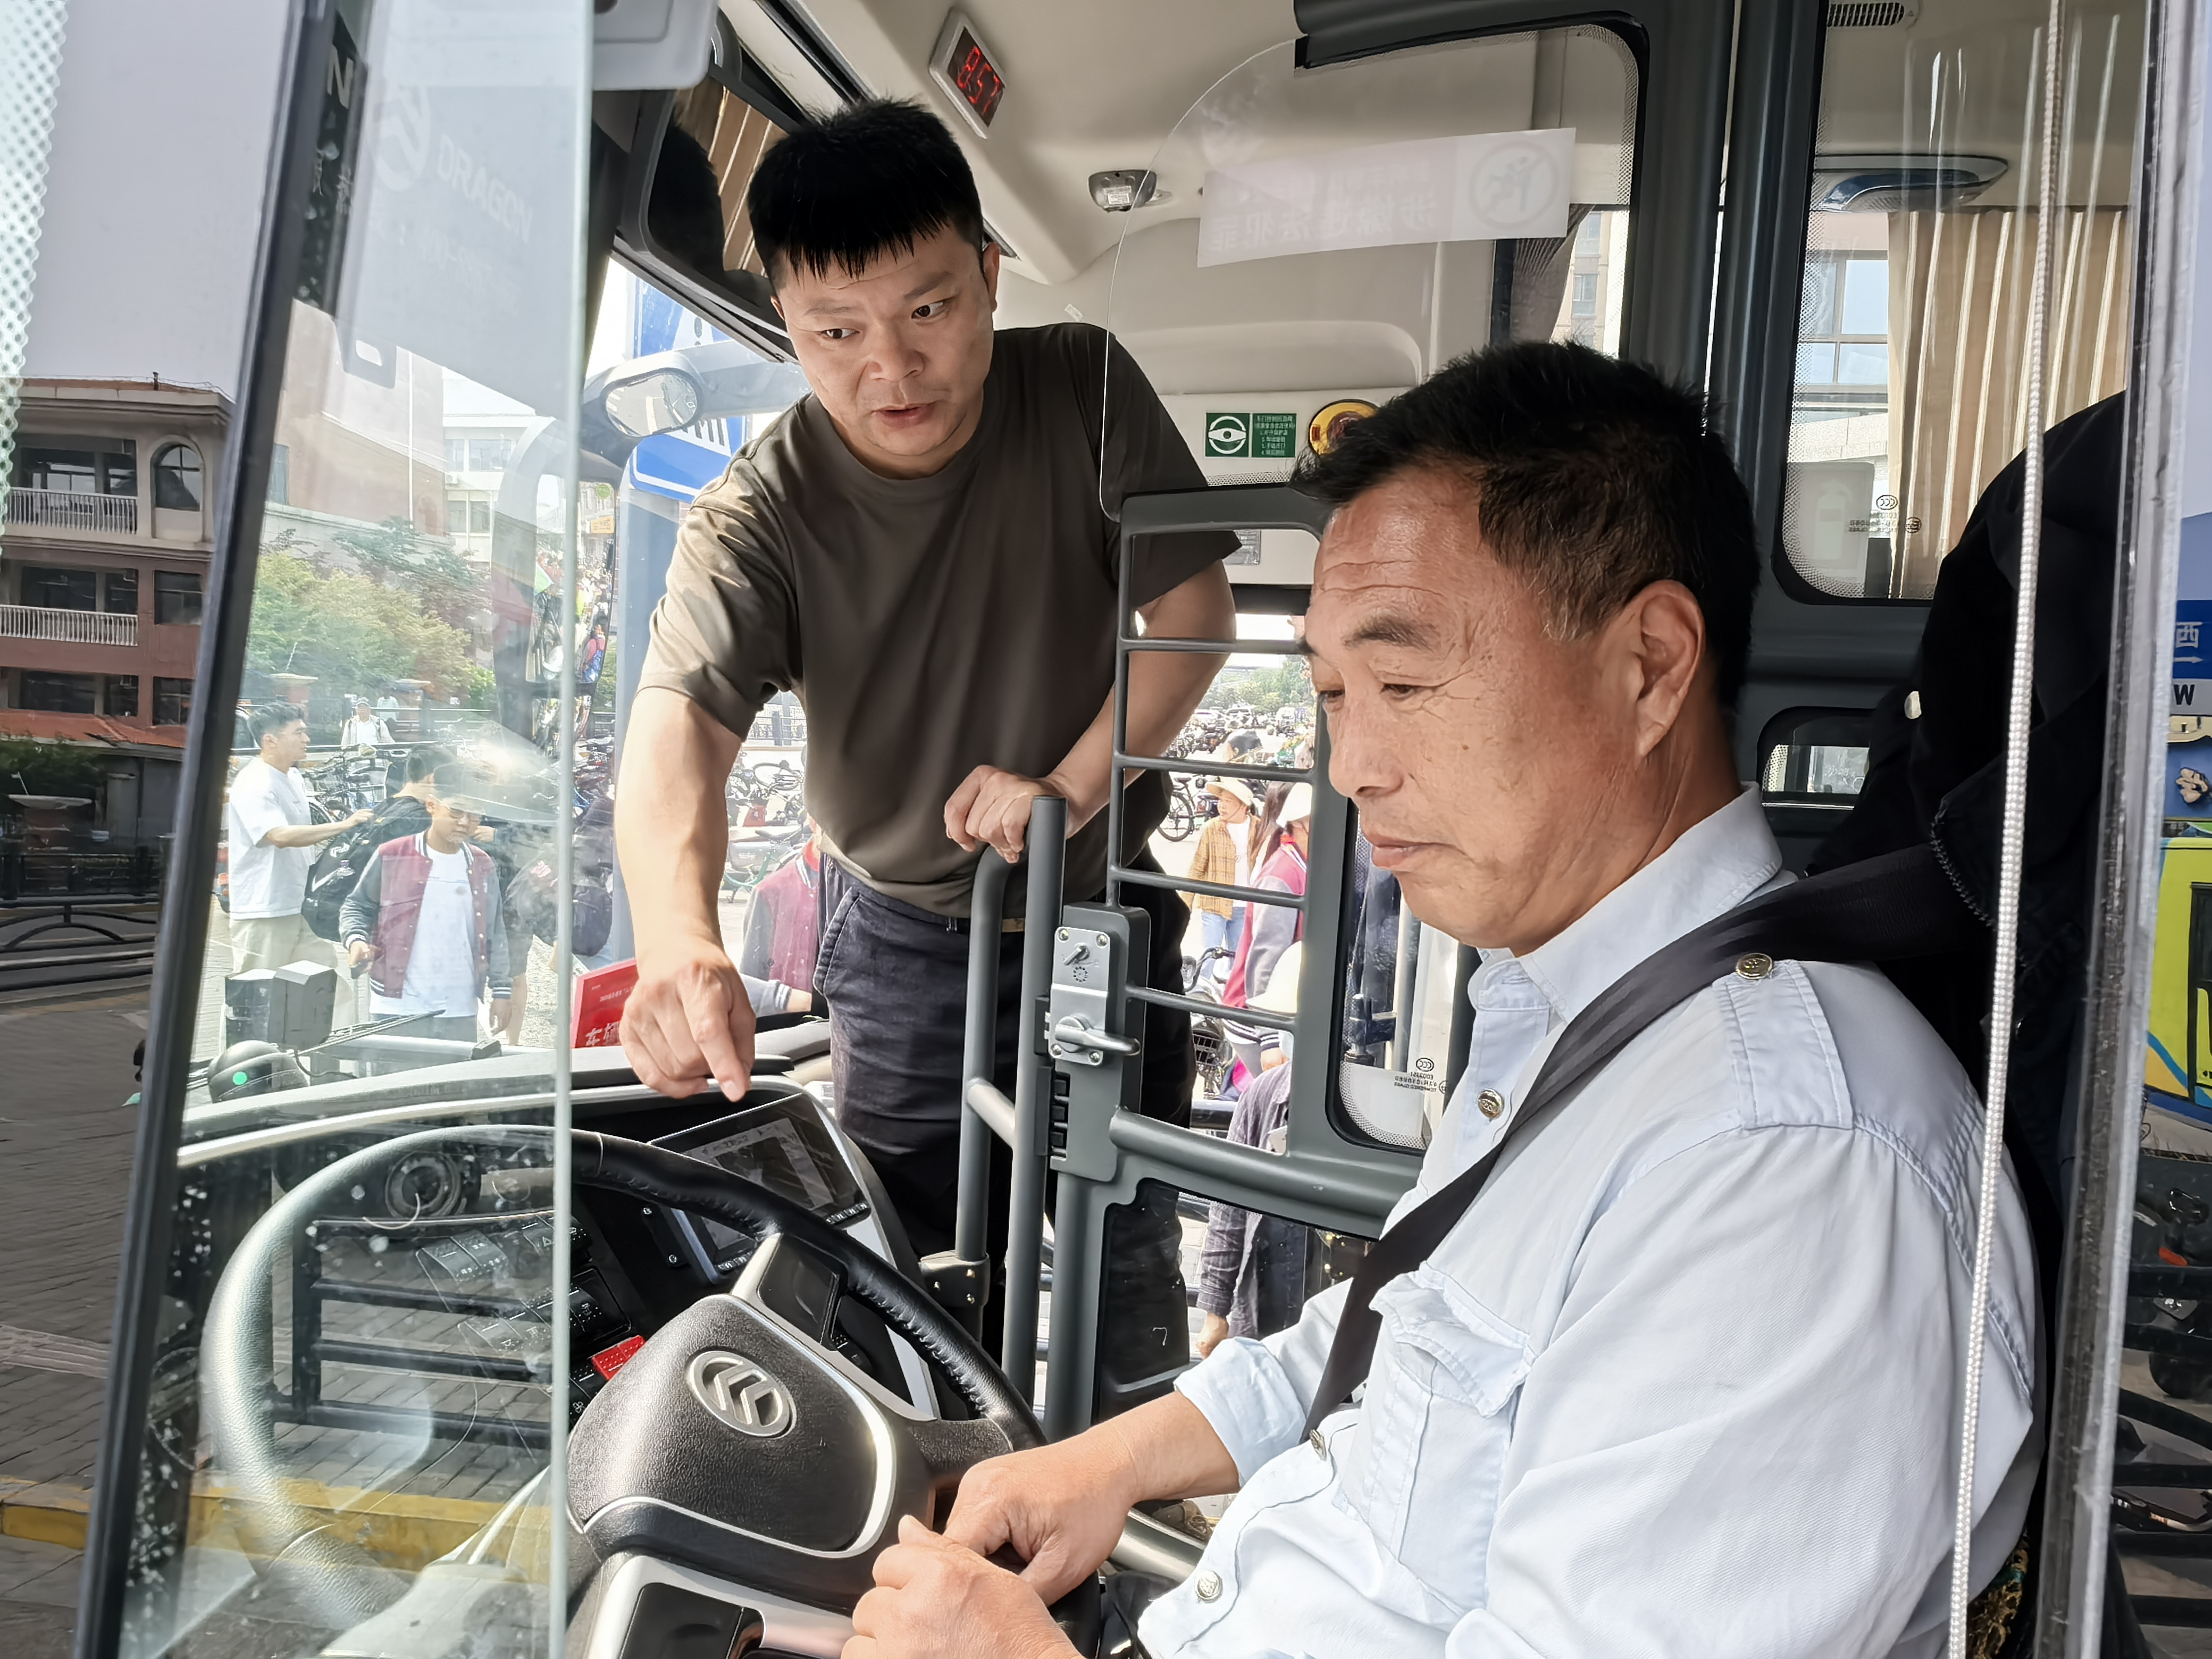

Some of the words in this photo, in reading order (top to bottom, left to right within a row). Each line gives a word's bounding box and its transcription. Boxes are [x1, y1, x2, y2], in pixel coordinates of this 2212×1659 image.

[436, 133, 533, 244] DRAGON
[2176, 621, 2203, 649] 西
[2173, 684, 2195, 706] W
